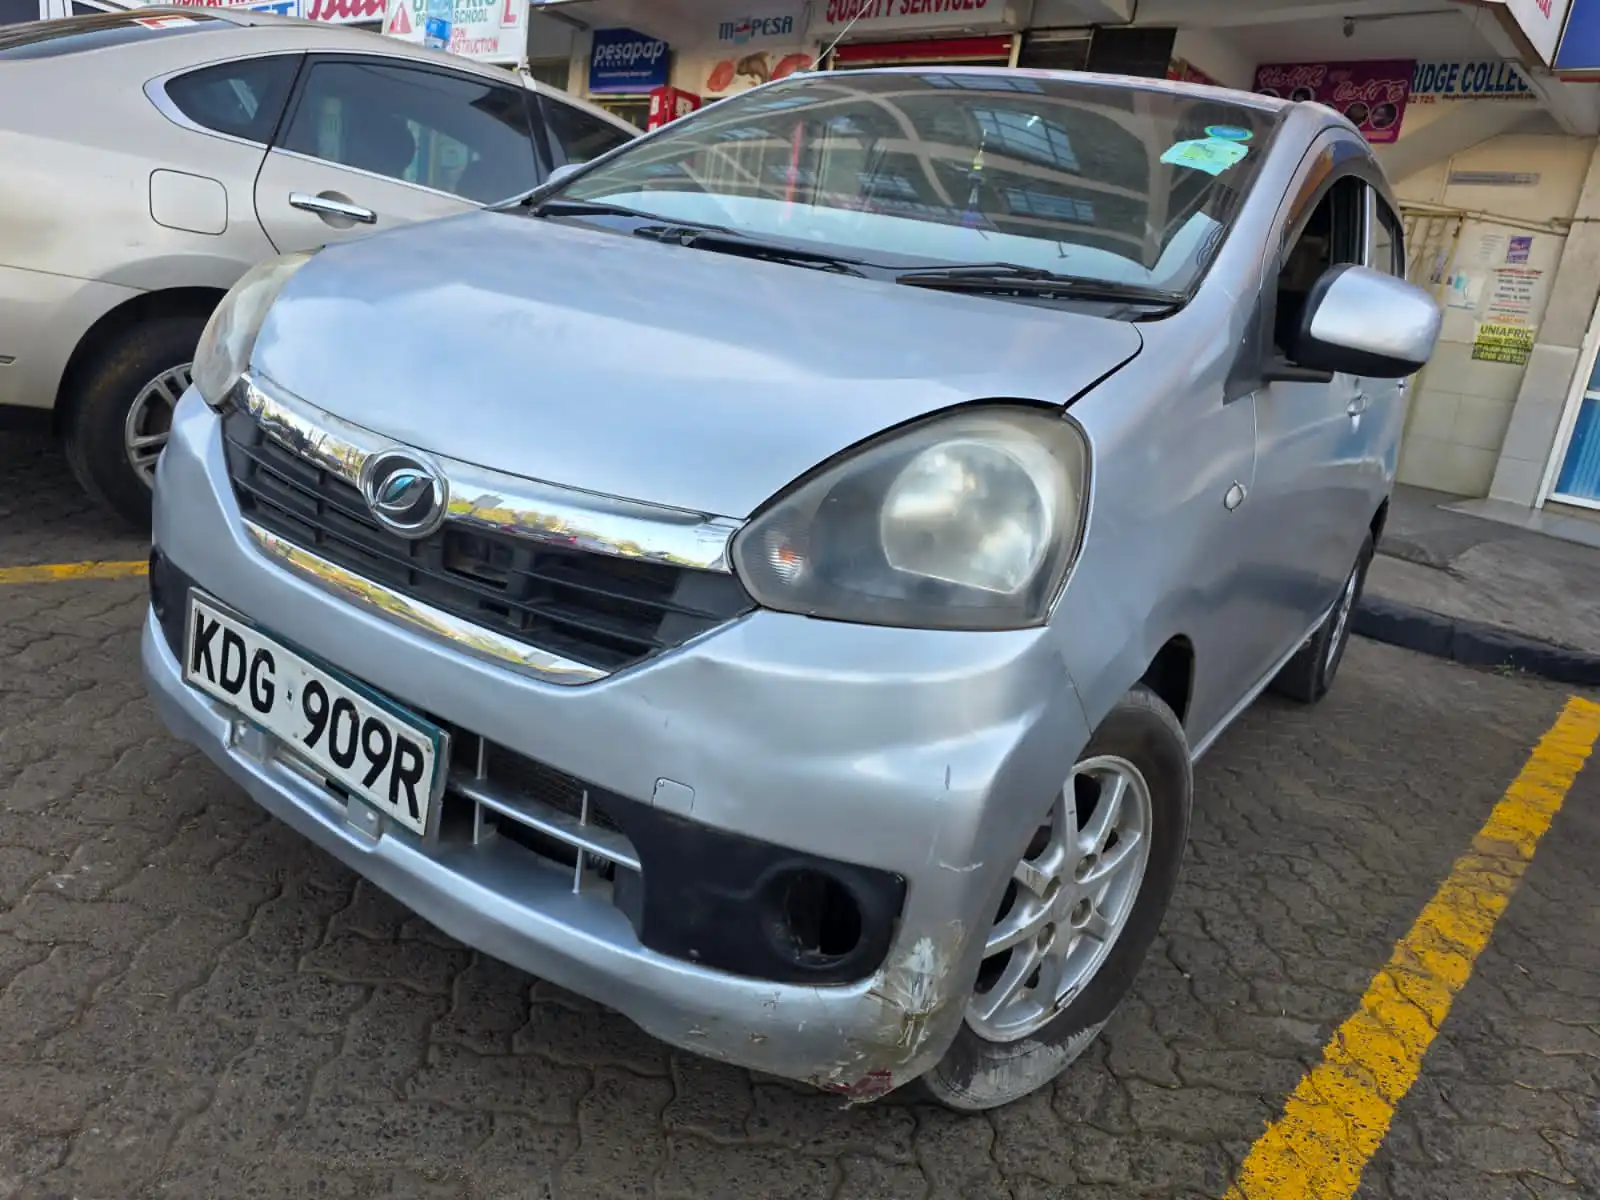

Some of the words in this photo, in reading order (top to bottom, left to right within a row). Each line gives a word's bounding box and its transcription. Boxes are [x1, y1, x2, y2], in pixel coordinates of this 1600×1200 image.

[593, 40, 665, 67] pesapap
[194, 611, 275, 714] KDG
[302, 680, 424, 820] 909R
